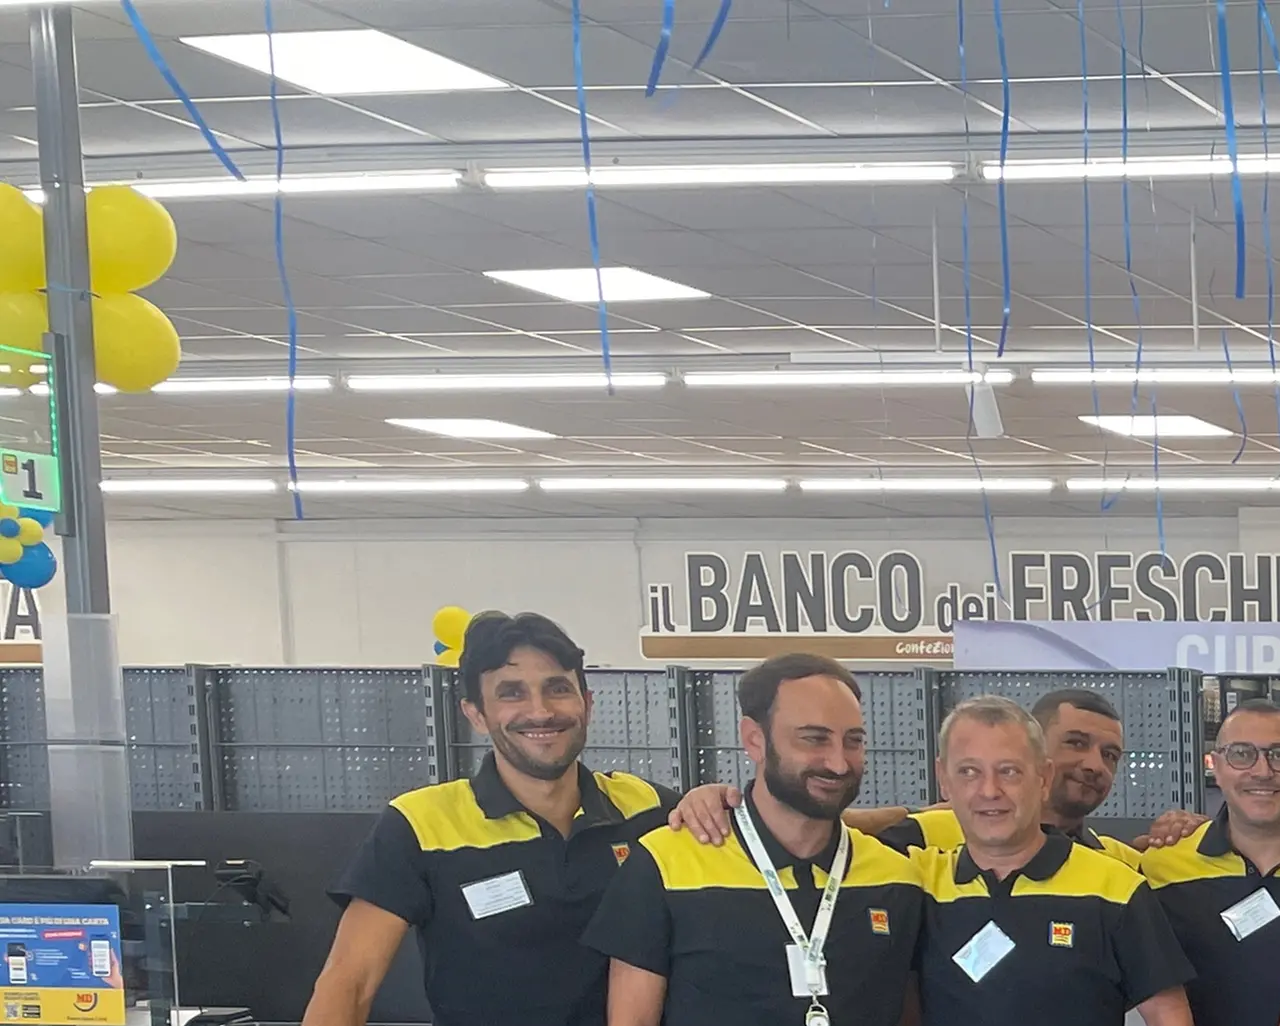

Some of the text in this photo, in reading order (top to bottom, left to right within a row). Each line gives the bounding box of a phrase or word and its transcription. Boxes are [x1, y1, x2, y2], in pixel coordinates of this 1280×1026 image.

[21, 459, 43, 500] 1
[650, 585, 676, 633] il
[686, 552, 922, 634] BANCO
[937, 583, 996, 632] dei
[1053, 926, 1071, 936] MD
